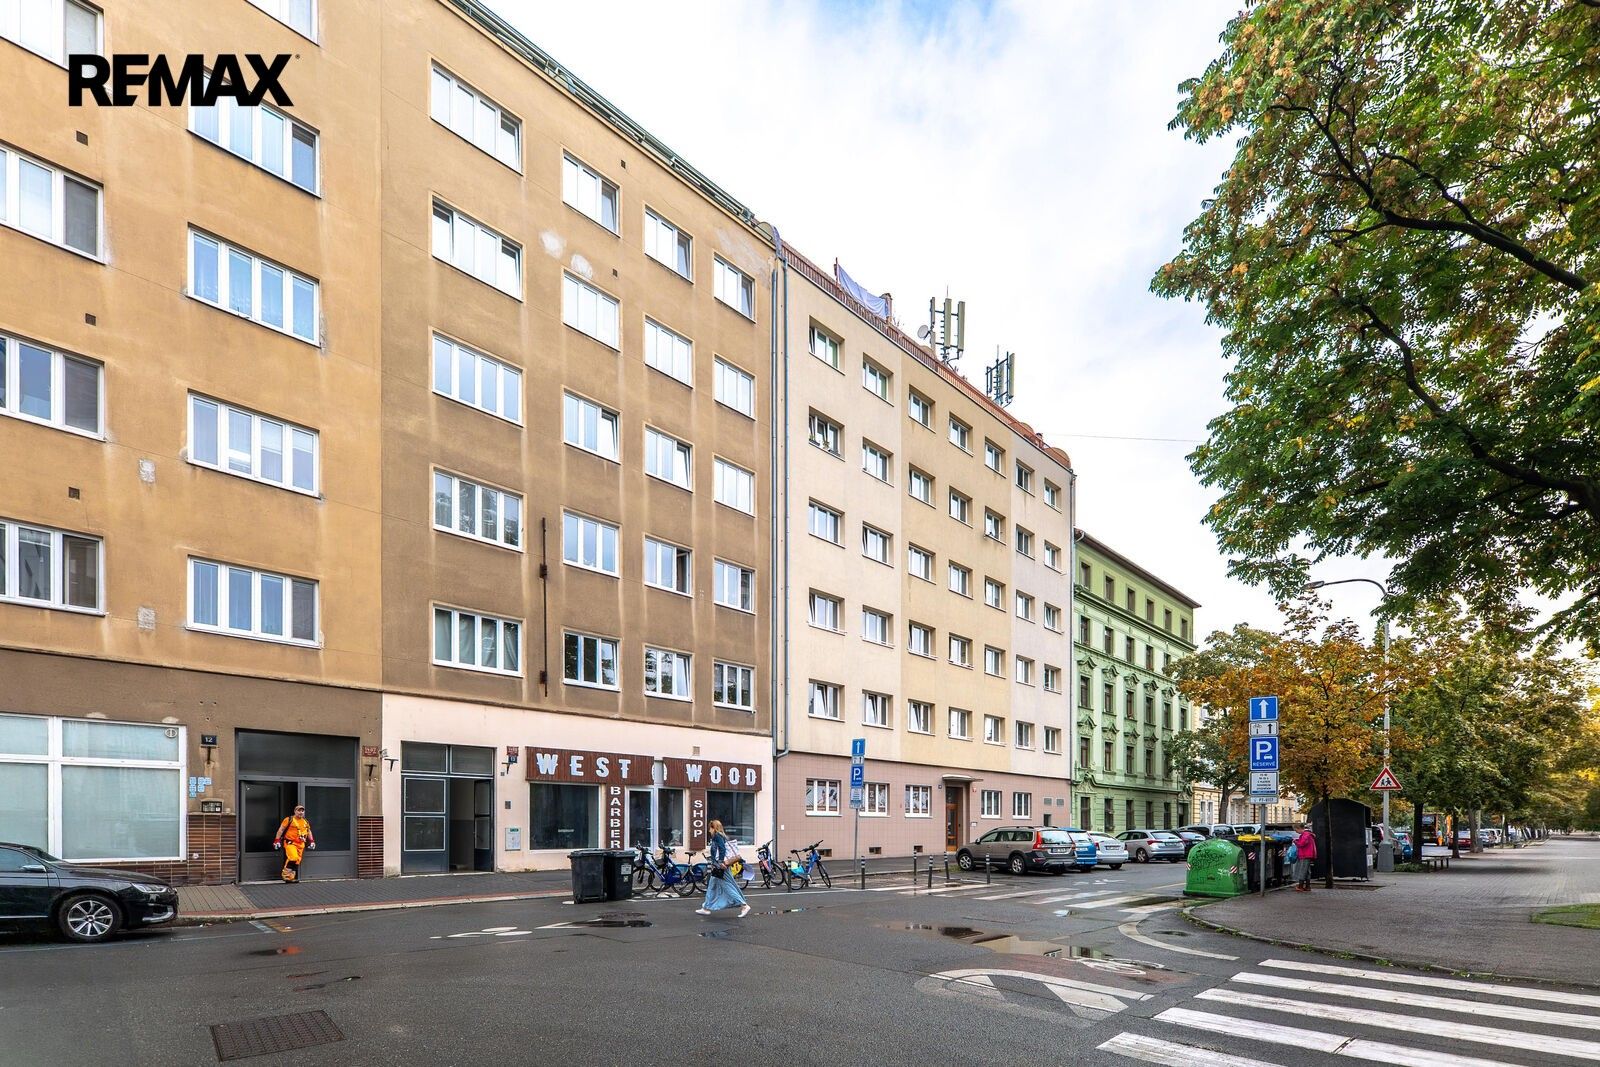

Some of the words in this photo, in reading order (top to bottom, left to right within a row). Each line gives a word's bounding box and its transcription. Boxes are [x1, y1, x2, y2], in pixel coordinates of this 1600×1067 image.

[1256, 740, 1272, 760] P
[535, 753, 632, 779] WEST
[685, 763, 758, 786] WOOD
[853, 768, 861, 781] P
[610, 786, 621, 849] BARBER
[693, 799, 703, 838] SHOP
